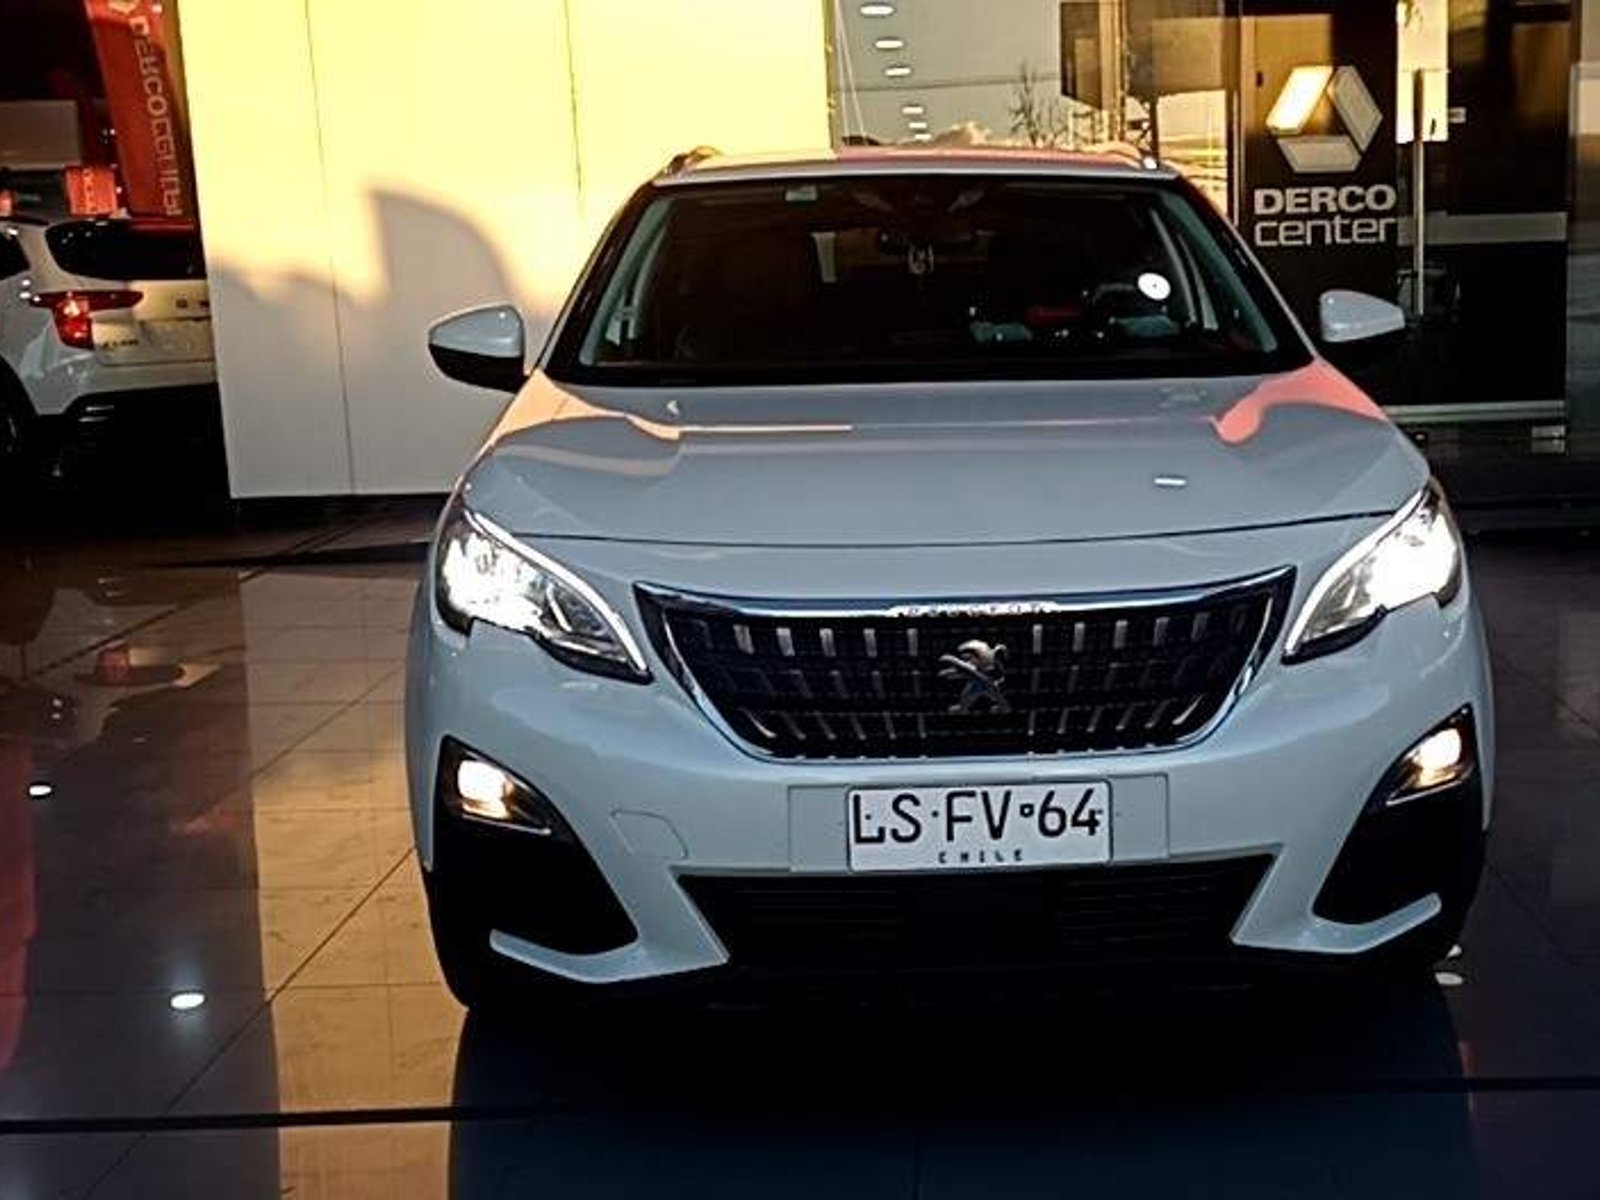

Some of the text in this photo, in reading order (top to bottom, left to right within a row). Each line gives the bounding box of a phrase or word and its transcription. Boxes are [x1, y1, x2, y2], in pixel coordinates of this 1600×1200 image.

[1254, 184, 1397, 215] DERCO
[1254, 214, 1397, 247] center
[937, 849, 1024, 864] CHILE
